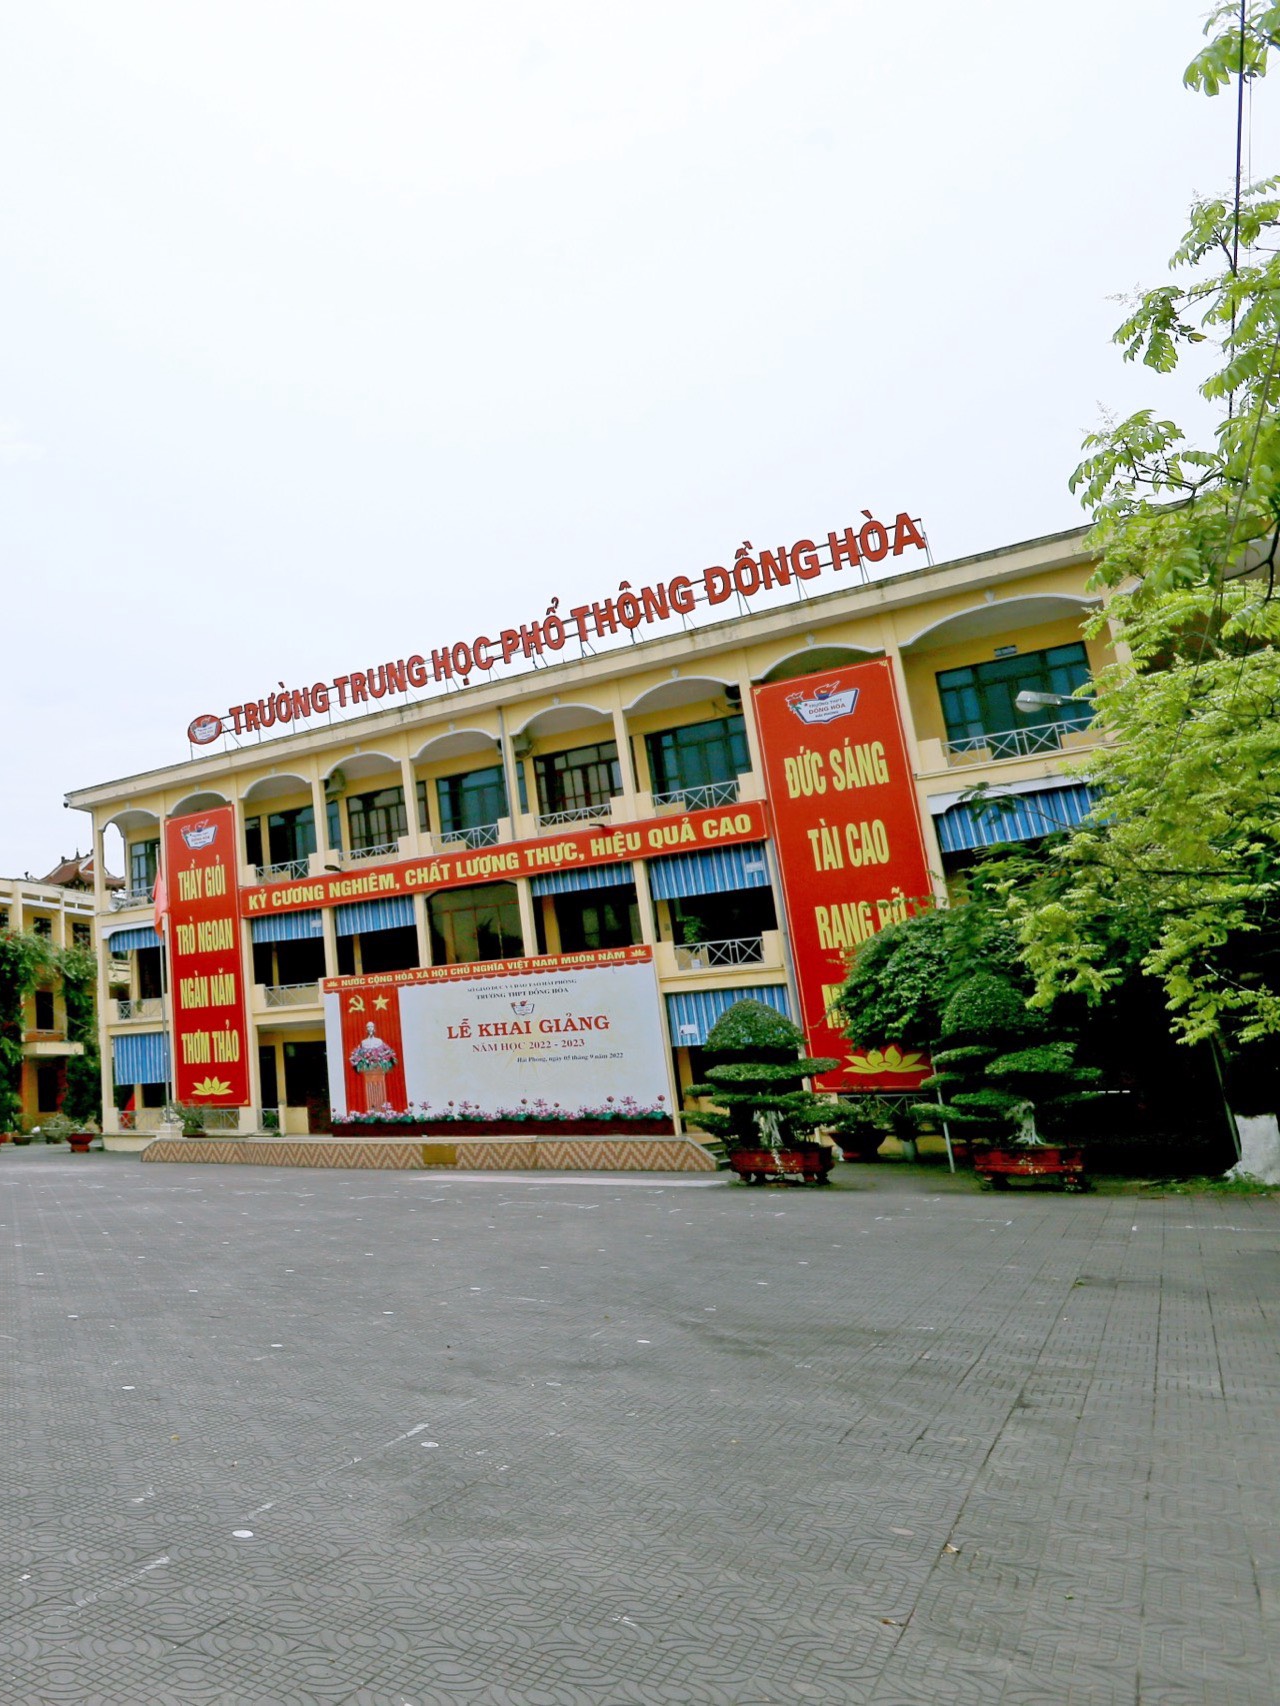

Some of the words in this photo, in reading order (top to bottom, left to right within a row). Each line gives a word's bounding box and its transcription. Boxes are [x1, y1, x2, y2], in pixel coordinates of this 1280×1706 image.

[228, 682, 330, 735] TRƯỜNG
[333, 655, 428, 707] TRUNG
[432, 636, 494, 686] HỌC
[500, 597, 566, 664] PHỔ
[570, 576, 696, 642] THÔNG
[703, 541, 822, 606] ĐỒNG
[827, 510, 927, 571] HÒA
[784, 746, 827, 799] ĐỨC
[829, 737, 890, 791] SÁNG
[248, 888, 267, 911] KỶ
[272, 884, 324, 907] CƯƠNG
[329, 872, 400, 897] NGHIÊM,
[405, 859, 450, 887] CHẤT
[456, 851, 520, 878] LƯỢNG
[524, 842, 584, 867] THỰC,
[590, 831, 642, 858] HIỆU
[648, 817, 696, 848] QUẢ
[702, 814, 752, 839] CAO
[807, 818, 844, 872] TÀI
[845, 819, 890, 868] CAO
[178, 859, 202, 901] THẦY
[204, 854, 226, 898] GIỎI
[176, 916, 196, 956] TRÒ
[197, 918, 234, 954] NGOAN
[814, 901, 874, 958] RẠNG
[180, 970, 209, 1010] NGÀN
[210, 968, 236, 1006] NĂM
[368, 974, 392, 985] CỘNG
[396, 972, 413, 982] HÒA
[432, 968, 448, 978] HỘI
[450, 965, 470, 976] CHỦ
[472, 962, 504, 973] NGHĨA
[507, 960, 530, 970] VIỆT
[532, 958, 558, 968] NAM
[561, 954, 595, 964] MUÔN
[181, 1029, 211, 1064] THƠM
[212, 1019, 240, 1063] THẢO
[447, 1018, 472, 1040] LỄ
[478, 1020, 532, 1038] KHAI
[538, 1012, 610, 1034] GIẢNG
[472, 1042, 498, 1053] NĂM
[501, 1042, 526, 1052] HỌC
[529, 1040, 552, 1050] 2022
[561, 1038, 585, 1048] 2023
